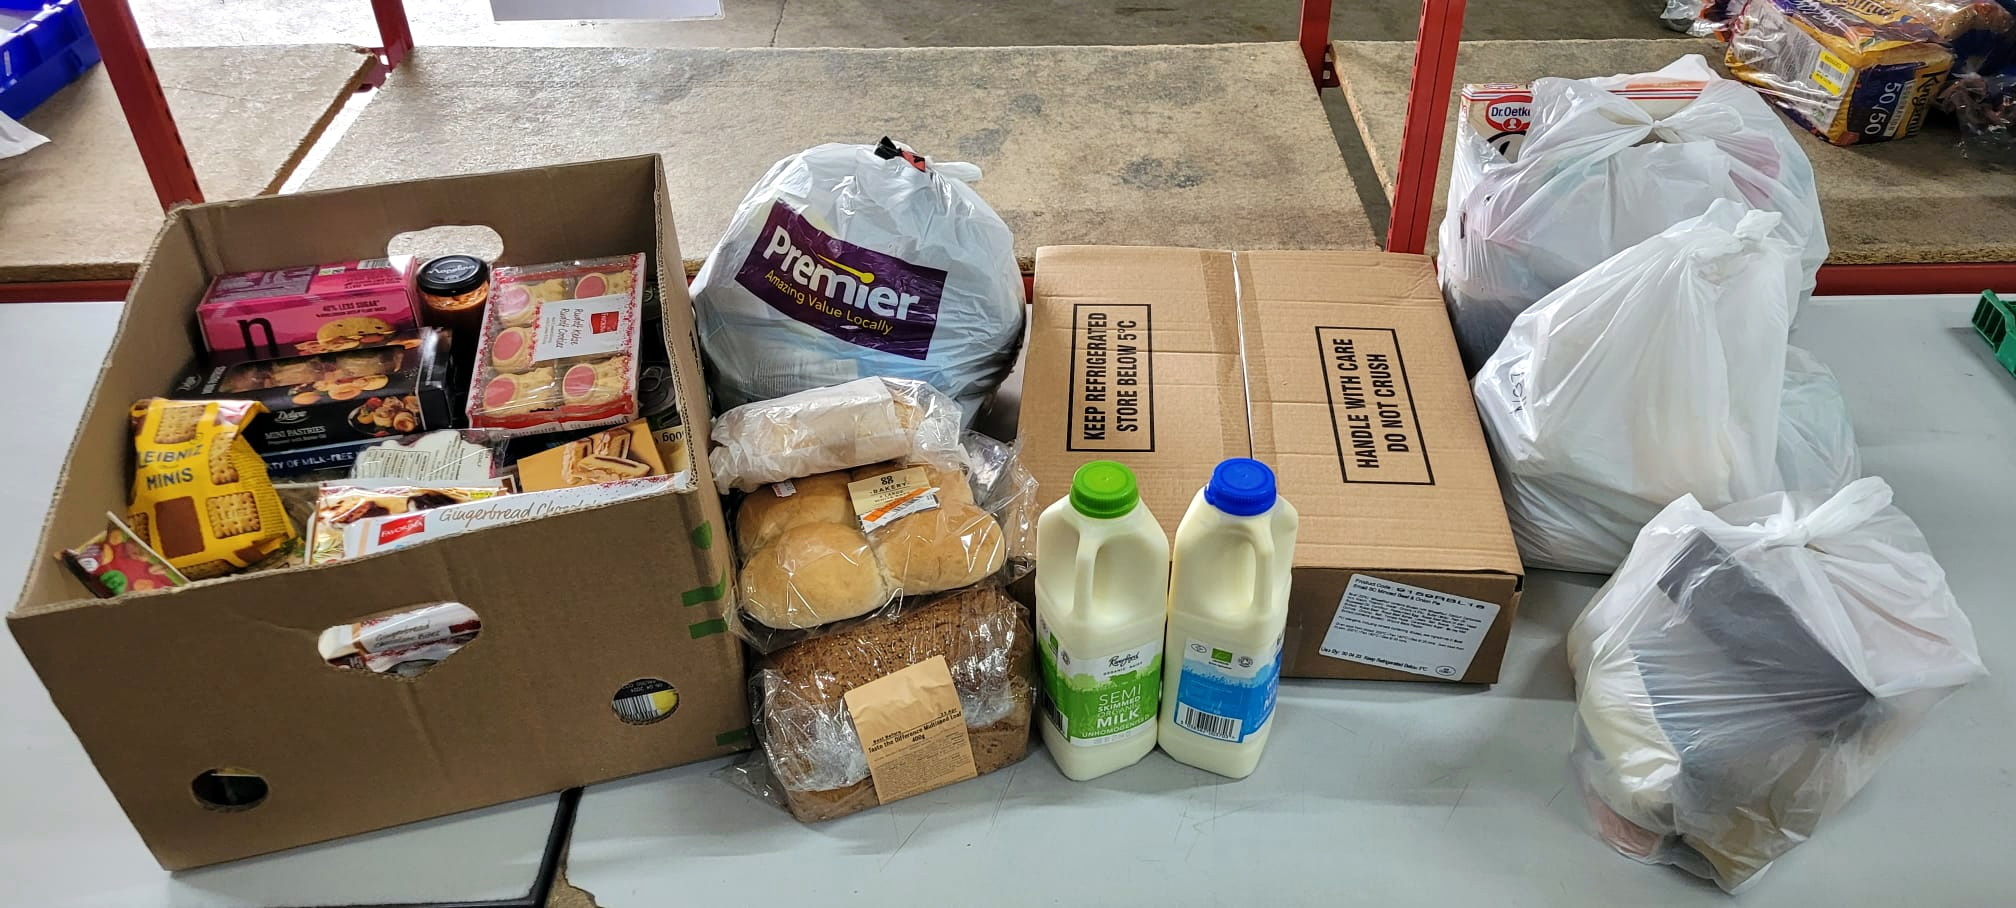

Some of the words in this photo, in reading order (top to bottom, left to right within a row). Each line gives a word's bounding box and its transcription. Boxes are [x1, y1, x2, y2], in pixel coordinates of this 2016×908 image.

[1864, 82, 1904, 135] 50/50
[763, 225, 920, 320] Premier
[765, 269, 804, 304] Amazing
[808, 294, 843, 319] Value
[846, 309, 893, 335] Locally
[1085, 312, 1108, 403] REFRIGERATED
[1117, 342, 1138, 387] BELOW
[1332, 337, 1358, 372] CARE
[1366, 352, 1396, 398] CRUSH
[1340, 374, 1365, 411] WITH
[1083, 407, 1106, 440] KEEP
[1117, 390, 1138, 432] STORE
[1377, 399, 1403, 432] NOT
[265, 430, 287, 440] MINI
[287, 425, 326, 437] PASTRIES
[1347, 414, 1379, 468] HANDLE
[1387, 433, 1410, 453] DO
[137, 445, 203, 469] LEIBNIZ
[286, 459, 299, 468] OF
[146, 467, 194, 491] MINIS
[873, 482, 906, 494] BAKERY
[440, 502, 535, 529] Gingerbread
[1098, 695, 1140, 712] SKIMMED
[1099, 683, 1141, 706] SEMI
[868, 745, 884, 753] Taste
[884, 740, 894, 748] the
[894, 728, 923, 743] Difference
[950, 711, 962, 720] Loaf
[1096, 707, 1140, 729] MILK
